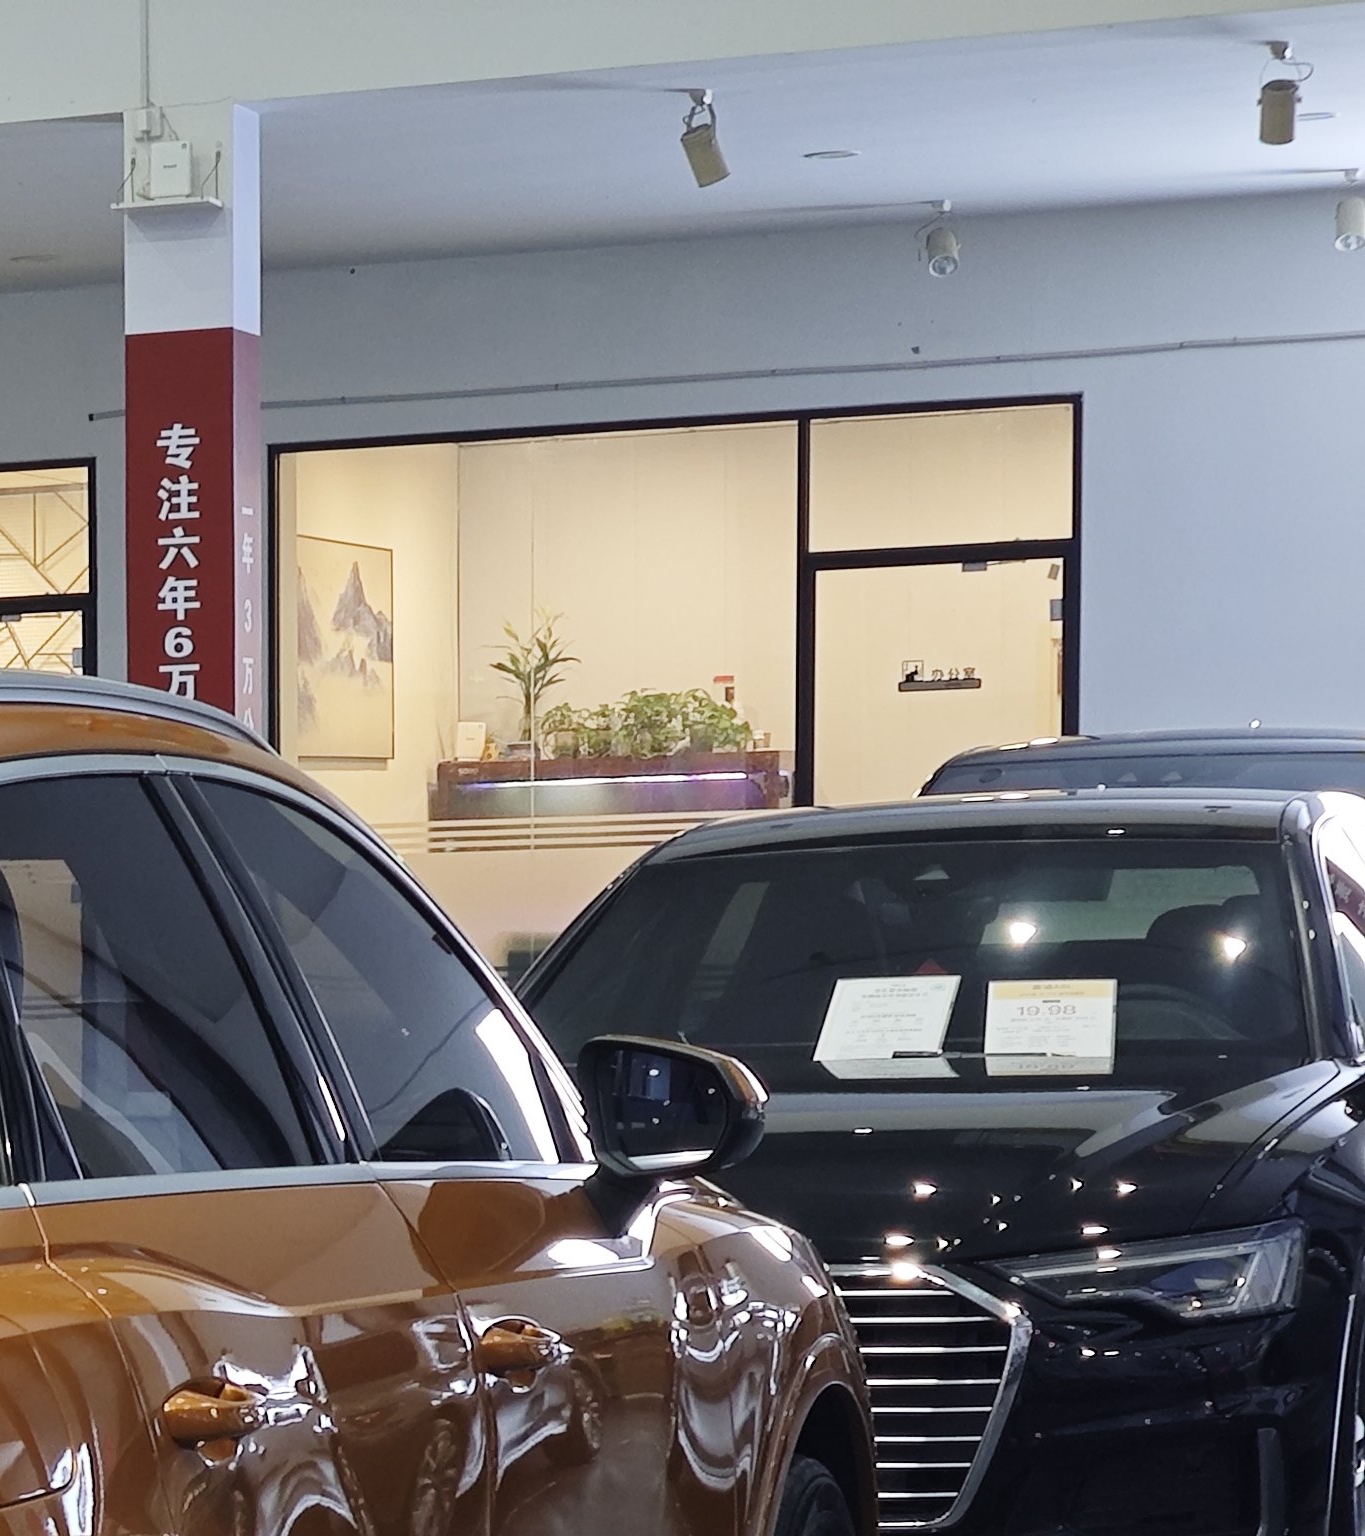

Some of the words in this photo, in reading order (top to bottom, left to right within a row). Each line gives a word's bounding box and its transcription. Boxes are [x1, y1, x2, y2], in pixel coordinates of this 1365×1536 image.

[156, 423, 201, 701] 专注六年6万
